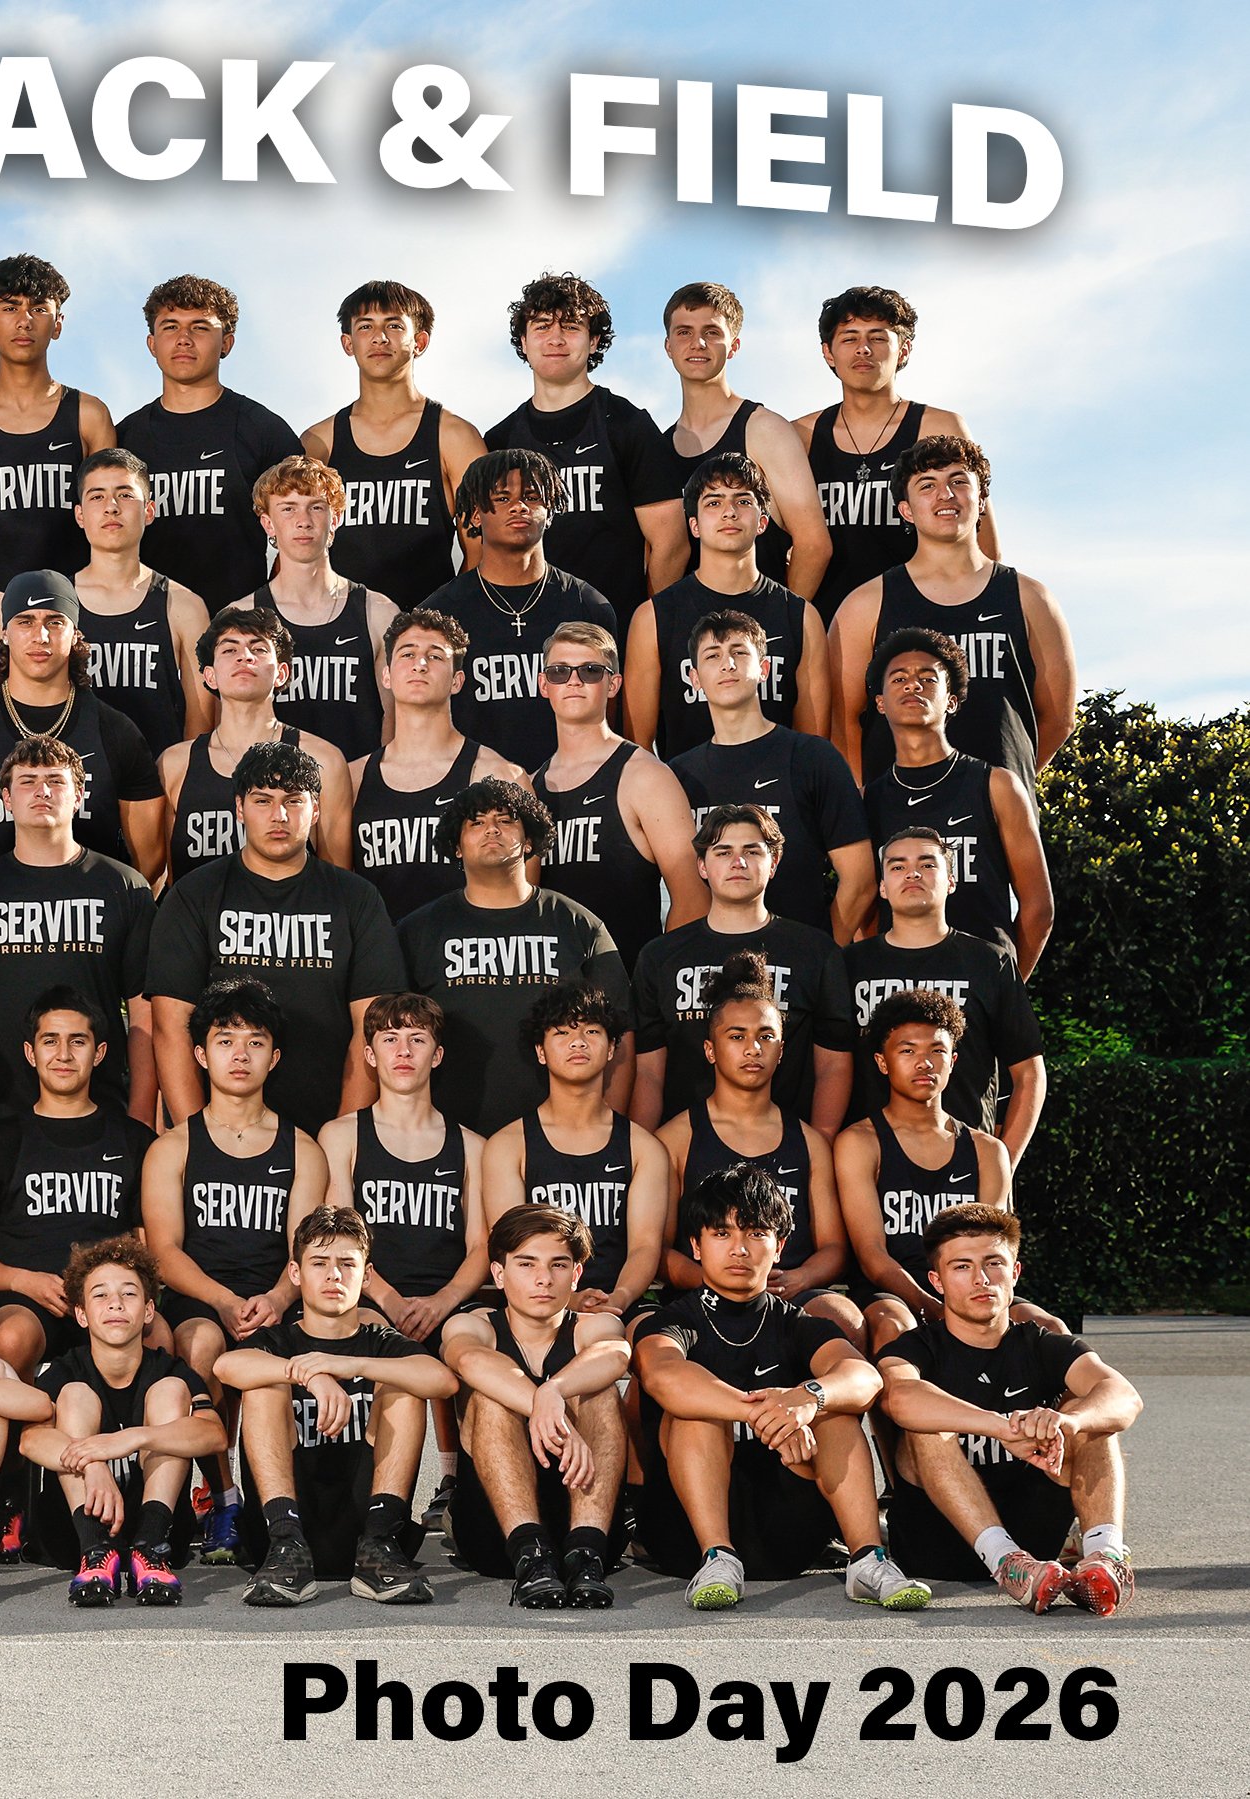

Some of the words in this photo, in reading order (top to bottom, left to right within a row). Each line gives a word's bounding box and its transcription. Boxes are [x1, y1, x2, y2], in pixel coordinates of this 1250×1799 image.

[149, 469, 225, 518] RVITE
[87, 643, 160, 690] RVITE
[273, 655, 359, 703] RVITE
[472, 653, 544, 702] SERV
[358, 816, 450, 869] SERVIT
[541, 816, 601, 866] VITE
[47, 943, 56, 955] &
[63, 943, 103, 954] FIELD
[218, 909, 333, 960] SERVITE
[444, 935, 560, 979] SERVITE
[218, 956, 272, 967] TRACK
[275, 957, 283, 968] &
[291, 958, 333, 970] FIELD
[446, 977, 499, 988] TRACK
[502, 976, 511, 986] &
[24, 1171, 123, 1219] SERVITE
[192, 1182, 288, 1232] SERVITE
[362, 1179, 459, 1232] SERVITE
